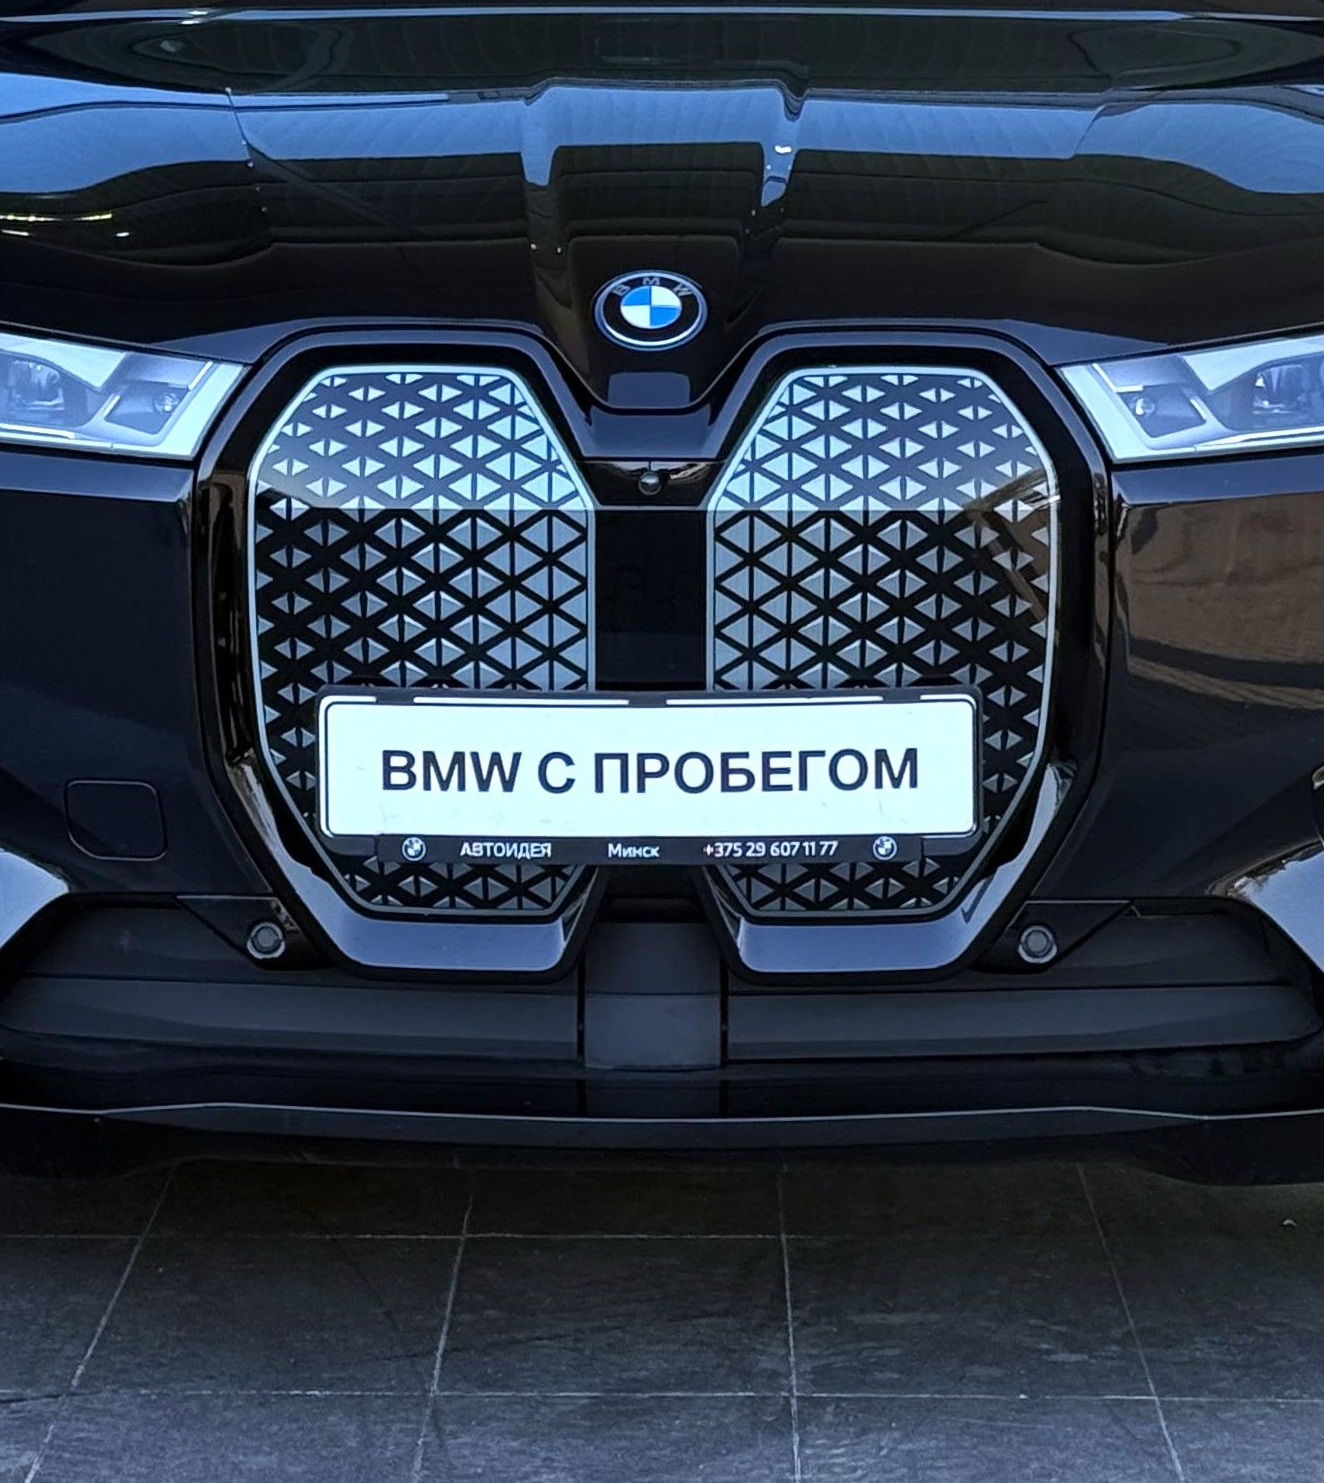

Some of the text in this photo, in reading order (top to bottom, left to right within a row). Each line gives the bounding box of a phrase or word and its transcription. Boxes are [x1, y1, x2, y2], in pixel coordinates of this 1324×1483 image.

[610, 276, 694, 297] BMW
[382, 747, 918, 794] BMW С ПРОБЕГОМ
[460, 841, 839, 860] АВТОИДЕЯ Минск +375 29 607 11 77
